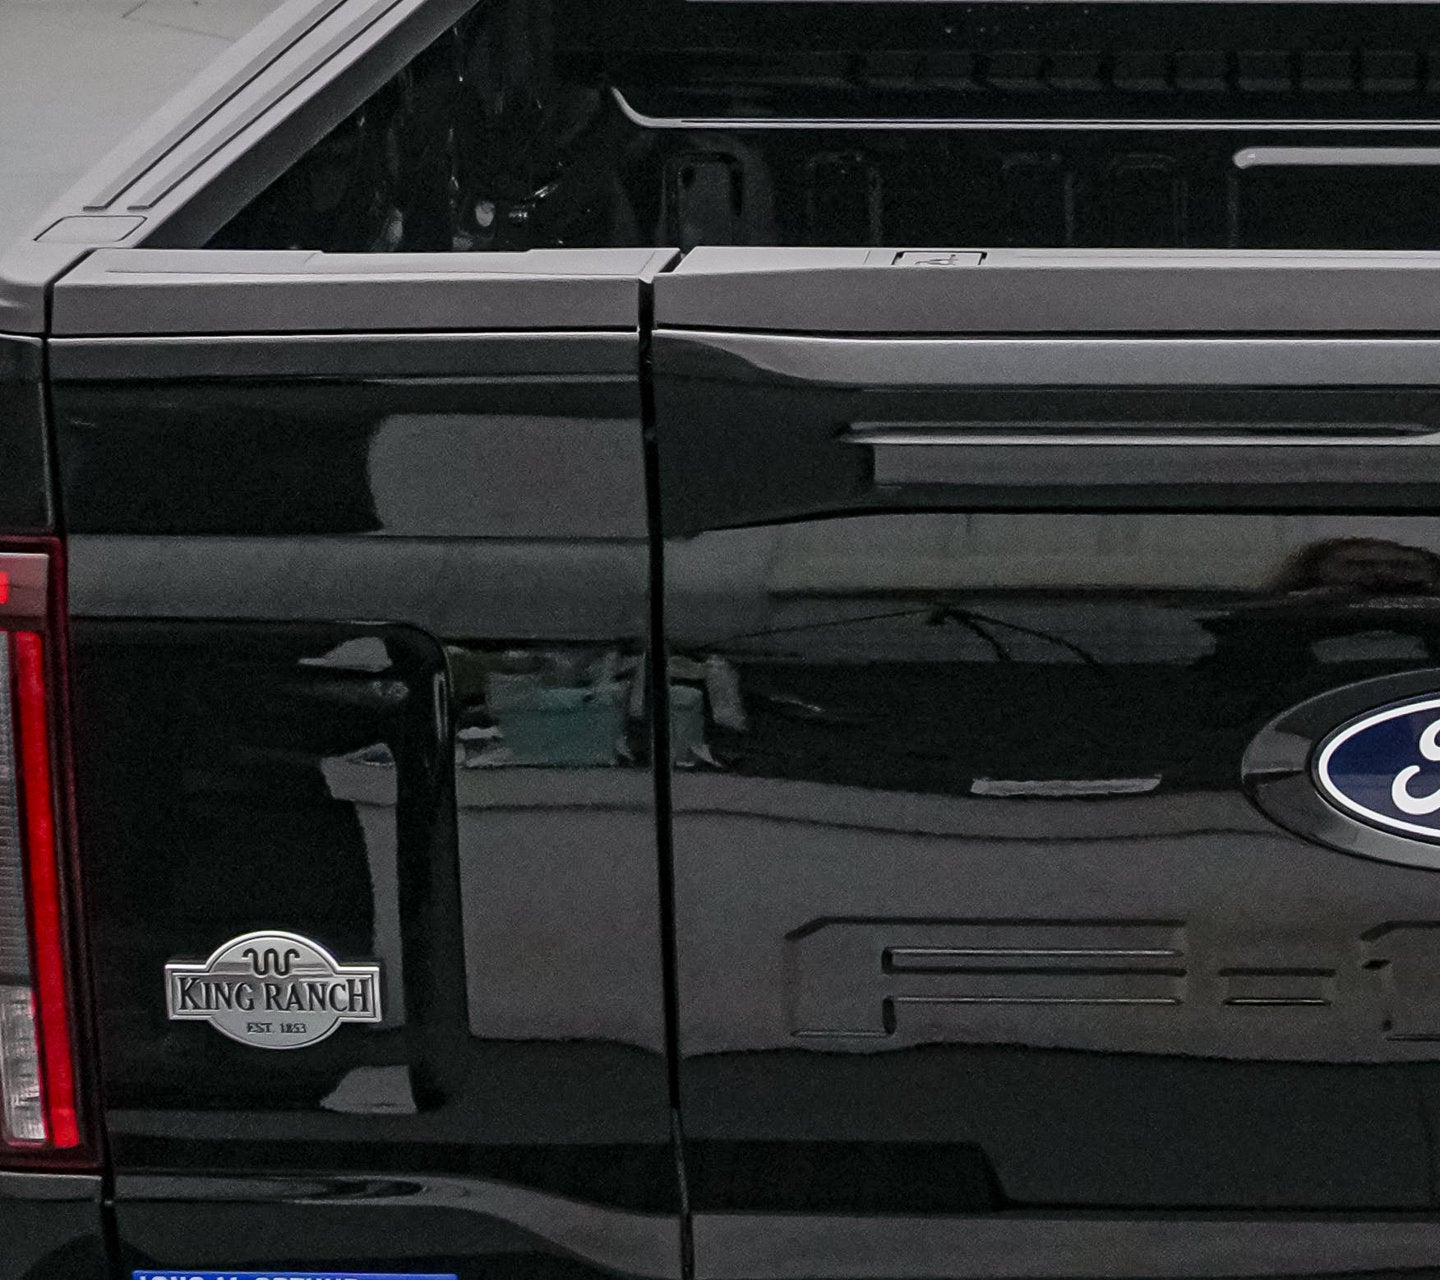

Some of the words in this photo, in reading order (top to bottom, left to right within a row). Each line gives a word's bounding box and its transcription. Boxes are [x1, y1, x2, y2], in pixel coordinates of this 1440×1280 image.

[177, 976, 255, 1012] KING
[265, 978, 372, 1013] RANCH
[279, 1022, 307, 1034] 1853
